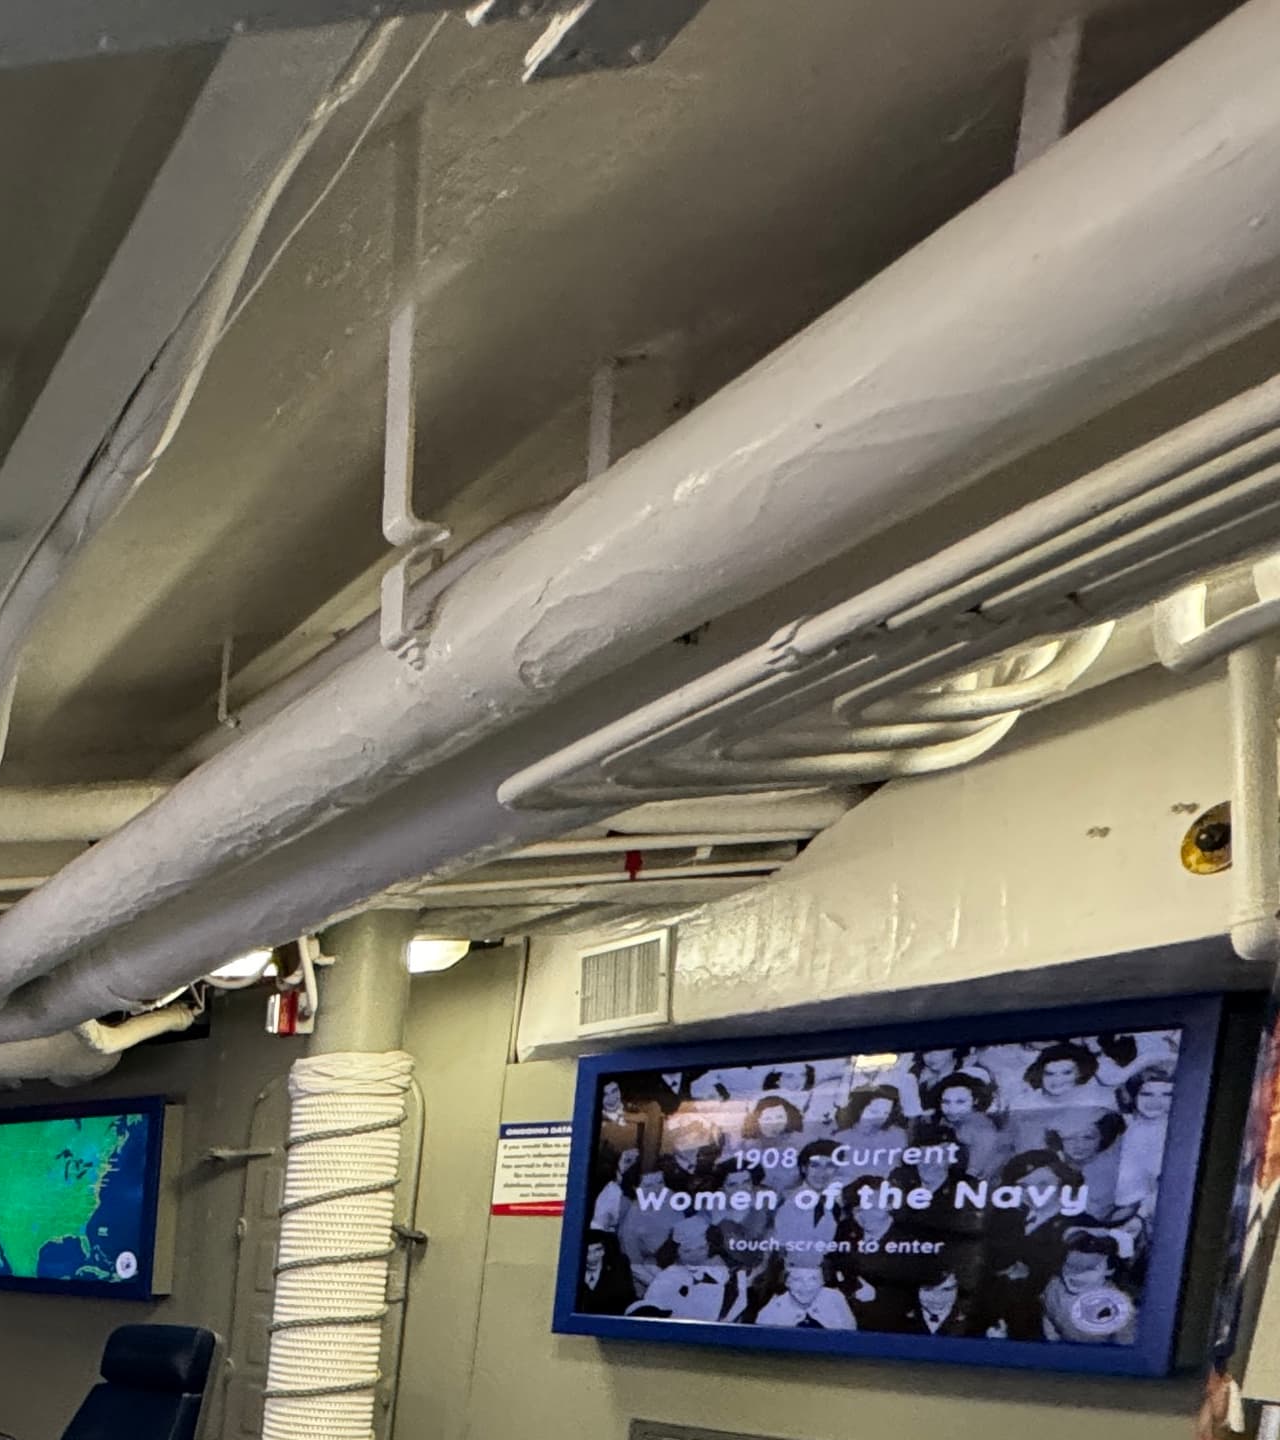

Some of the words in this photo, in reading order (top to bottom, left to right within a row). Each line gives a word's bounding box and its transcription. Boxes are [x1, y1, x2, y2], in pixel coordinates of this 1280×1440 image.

[734, 1148, 798, 1170] 1908
[831, 1143, 961, 1169] Current
[636, 1186, 778, 1212] Women
[794, 1181, 841, 1212] of
[857, 1181, 934, 1210] the
[954, 1180, 1090, 1216] Navy
[728, 1236, 781, 1253] touch
[785, 1240, 850, 1254] screen
[857, 1238, 880, 1254] to
[884, 1240, 946, 1254] enter
